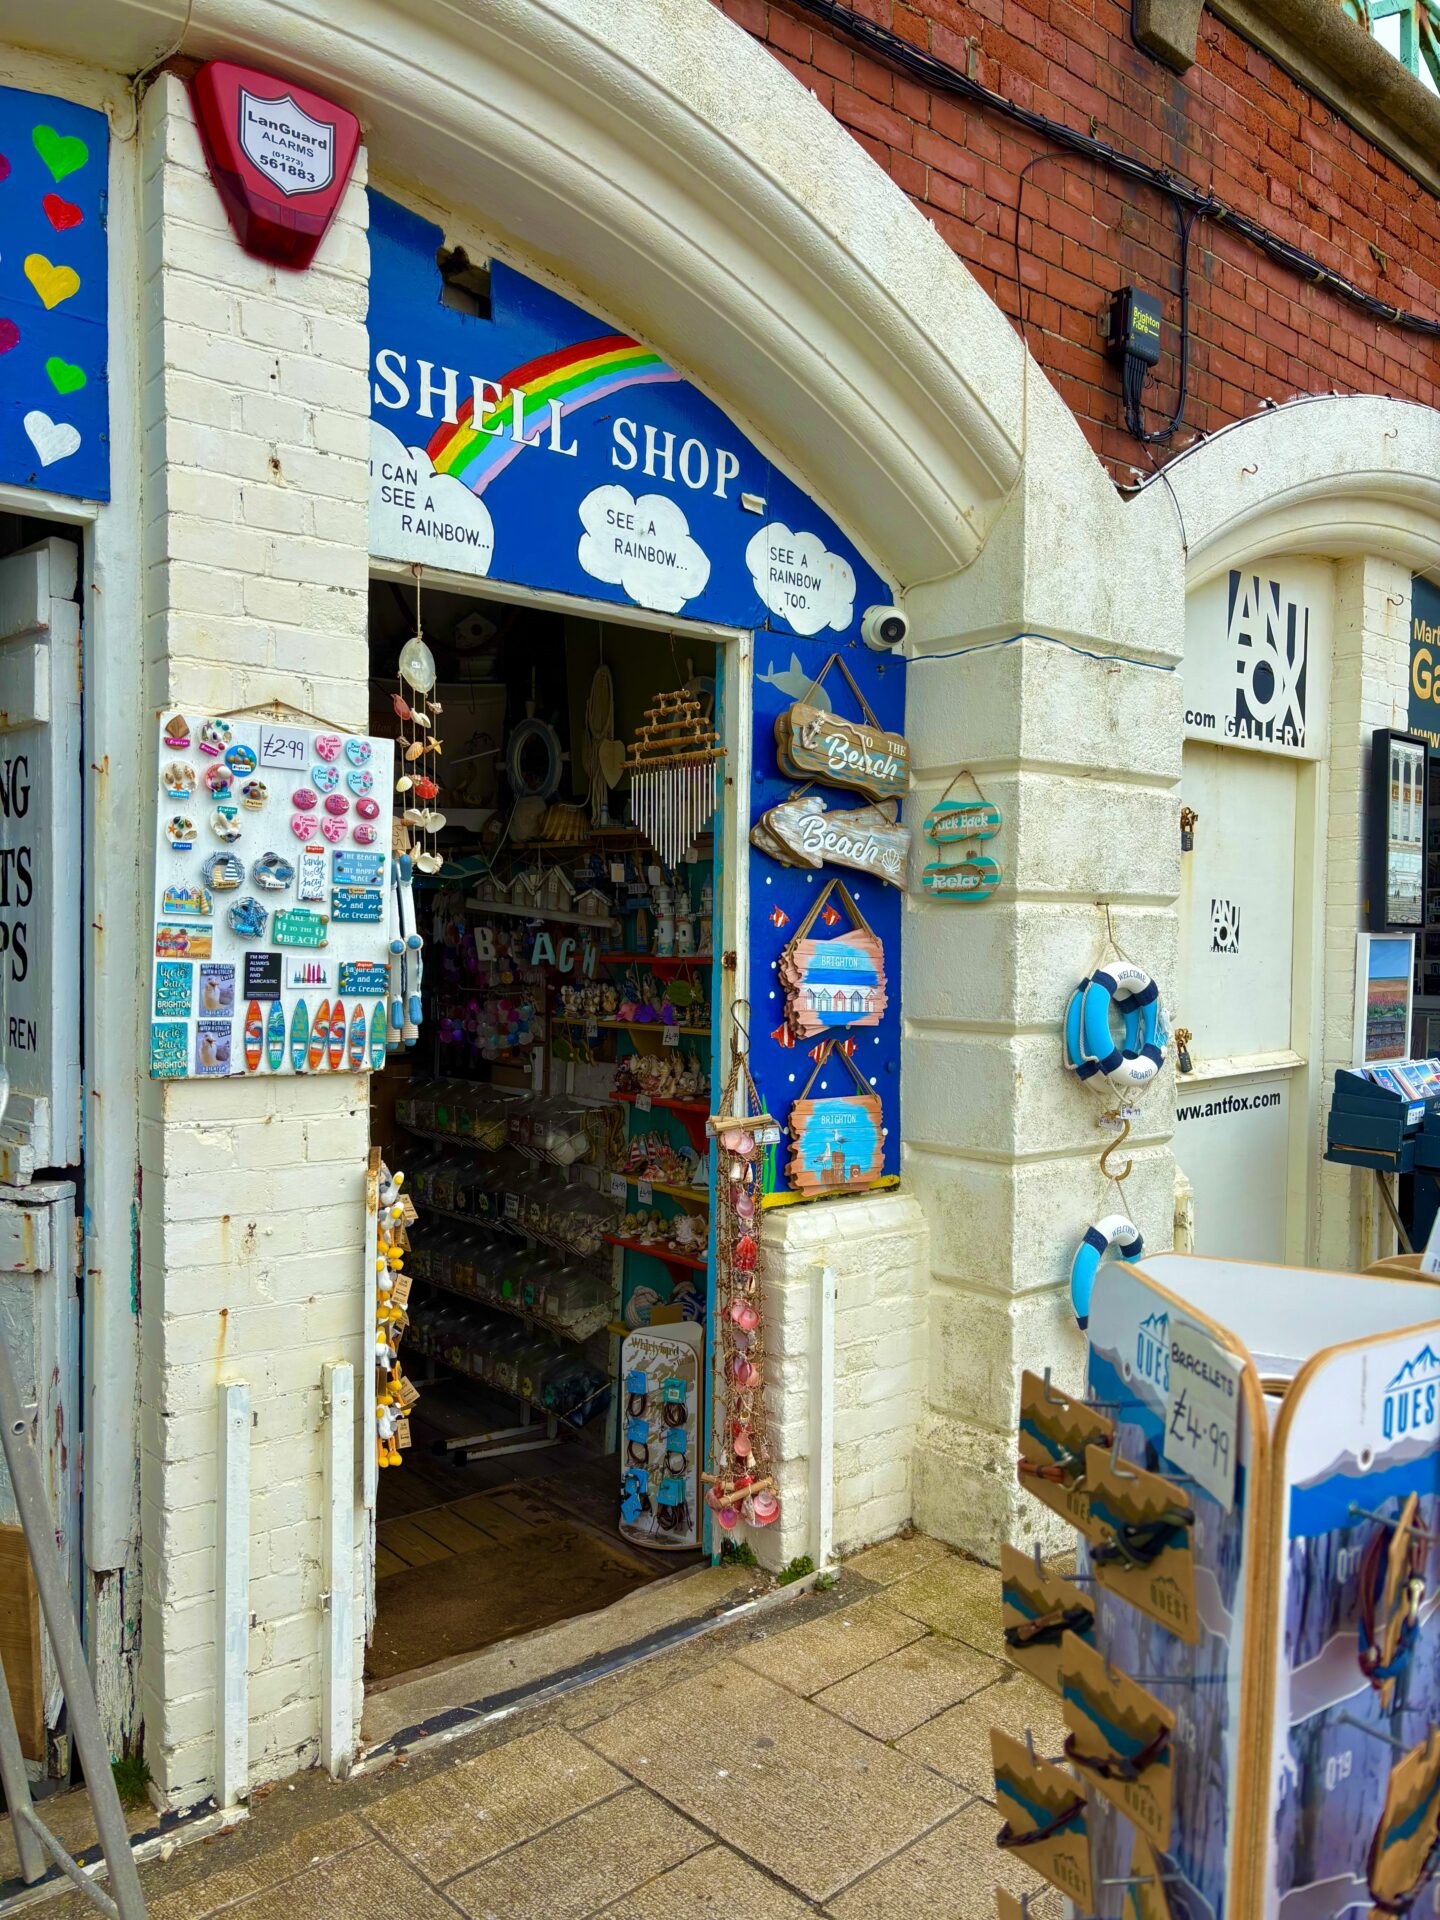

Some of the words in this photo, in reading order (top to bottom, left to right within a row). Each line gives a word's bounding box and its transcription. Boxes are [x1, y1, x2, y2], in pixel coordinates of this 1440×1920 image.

[248, 110, 327, 150] LanGuard
[262, 132, 314, 157] ALARMS
[260, 154, 315, 183] 561883
[272, 150, 303, 168] (01273)
[1133, 306, 1160, 329] Brighton
[1133, 317, 1148, 334] Fibre
[374, 349, 578, 457] SHELL
[612, 417, 740, 499] SHOP
[369, 460, 374, 477] I
[381, 463, 418, 486] CAN
[381, 486, 416, 509] SEE
[424, 496, 435, 512] A
[401, 514, 490, 549] RAINBOW...
[606, 509, 634, 531] SEE
[648, 520, 656, 536] A
[614, 538, 688, 571] RAINBOW...
[770, 546, 794, 565] SEE
[801, 554, 808, 568] A
[769, 567, 821, 591] RAINBOW
[784, 592, 811, 610] TOO.
[1227, 569, 1308, 656] ANT
[1225, 715, 1306, 748] GALLERY
[825, 733, 898, 781] Beach
[887, 741, 907, 757] THE
[960, 812, 988, 828] Back
[799, 814, 880, 864] Beach
[338, 911, 349, 919] Ice
[352, 911, 379, 920] Creams
[283, 934, 318, 945] BEACH
[821, 955, 858, 967] BRIGHTON
[1117, 969, 1147, 983] WELCOME
[157, 1000, 191, 1008] BRIGHTON
[153, 1060, 187, 1069] BRIGHTON
[1128, 1069, 1153, 1080] ABOARD
[820, 1113, 857, 1125] BRIGHTON
[1111, 1225, 1136, 1238] WELCOME
[1171, 1342, 1235, 1398] BRACELETS
[1151, 1584, 1189, 1625] QUEST
[1325, 1750, 1352, 1791] Q19
[1052, 1852, 1088, 1897] QUEST
